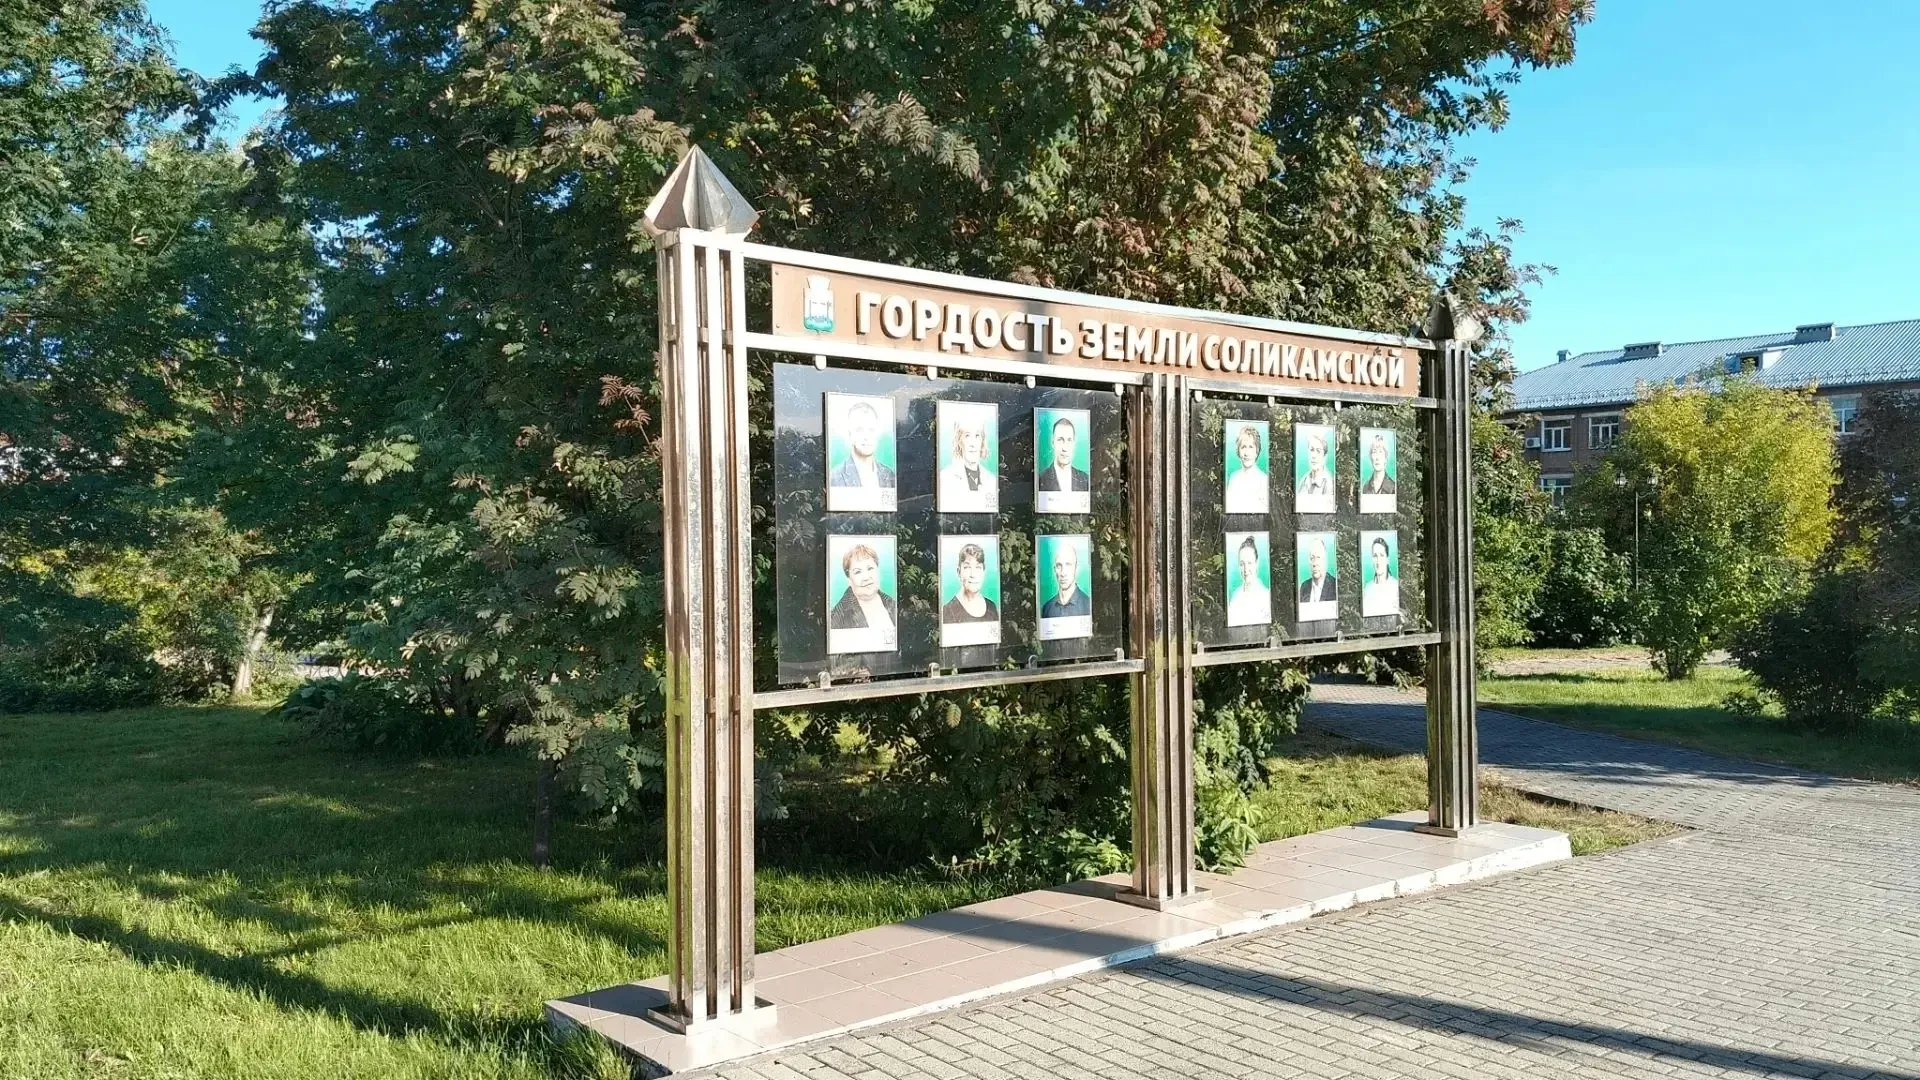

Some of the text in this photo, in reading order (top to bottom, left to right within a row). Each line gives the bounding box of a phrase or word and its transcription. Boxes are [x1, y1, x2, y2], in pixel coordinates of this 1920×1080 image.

[856, 291, 1404, 388] ГОРДОСТЬ ЗЕМЛИ СОЛИКАМСКОЙ
